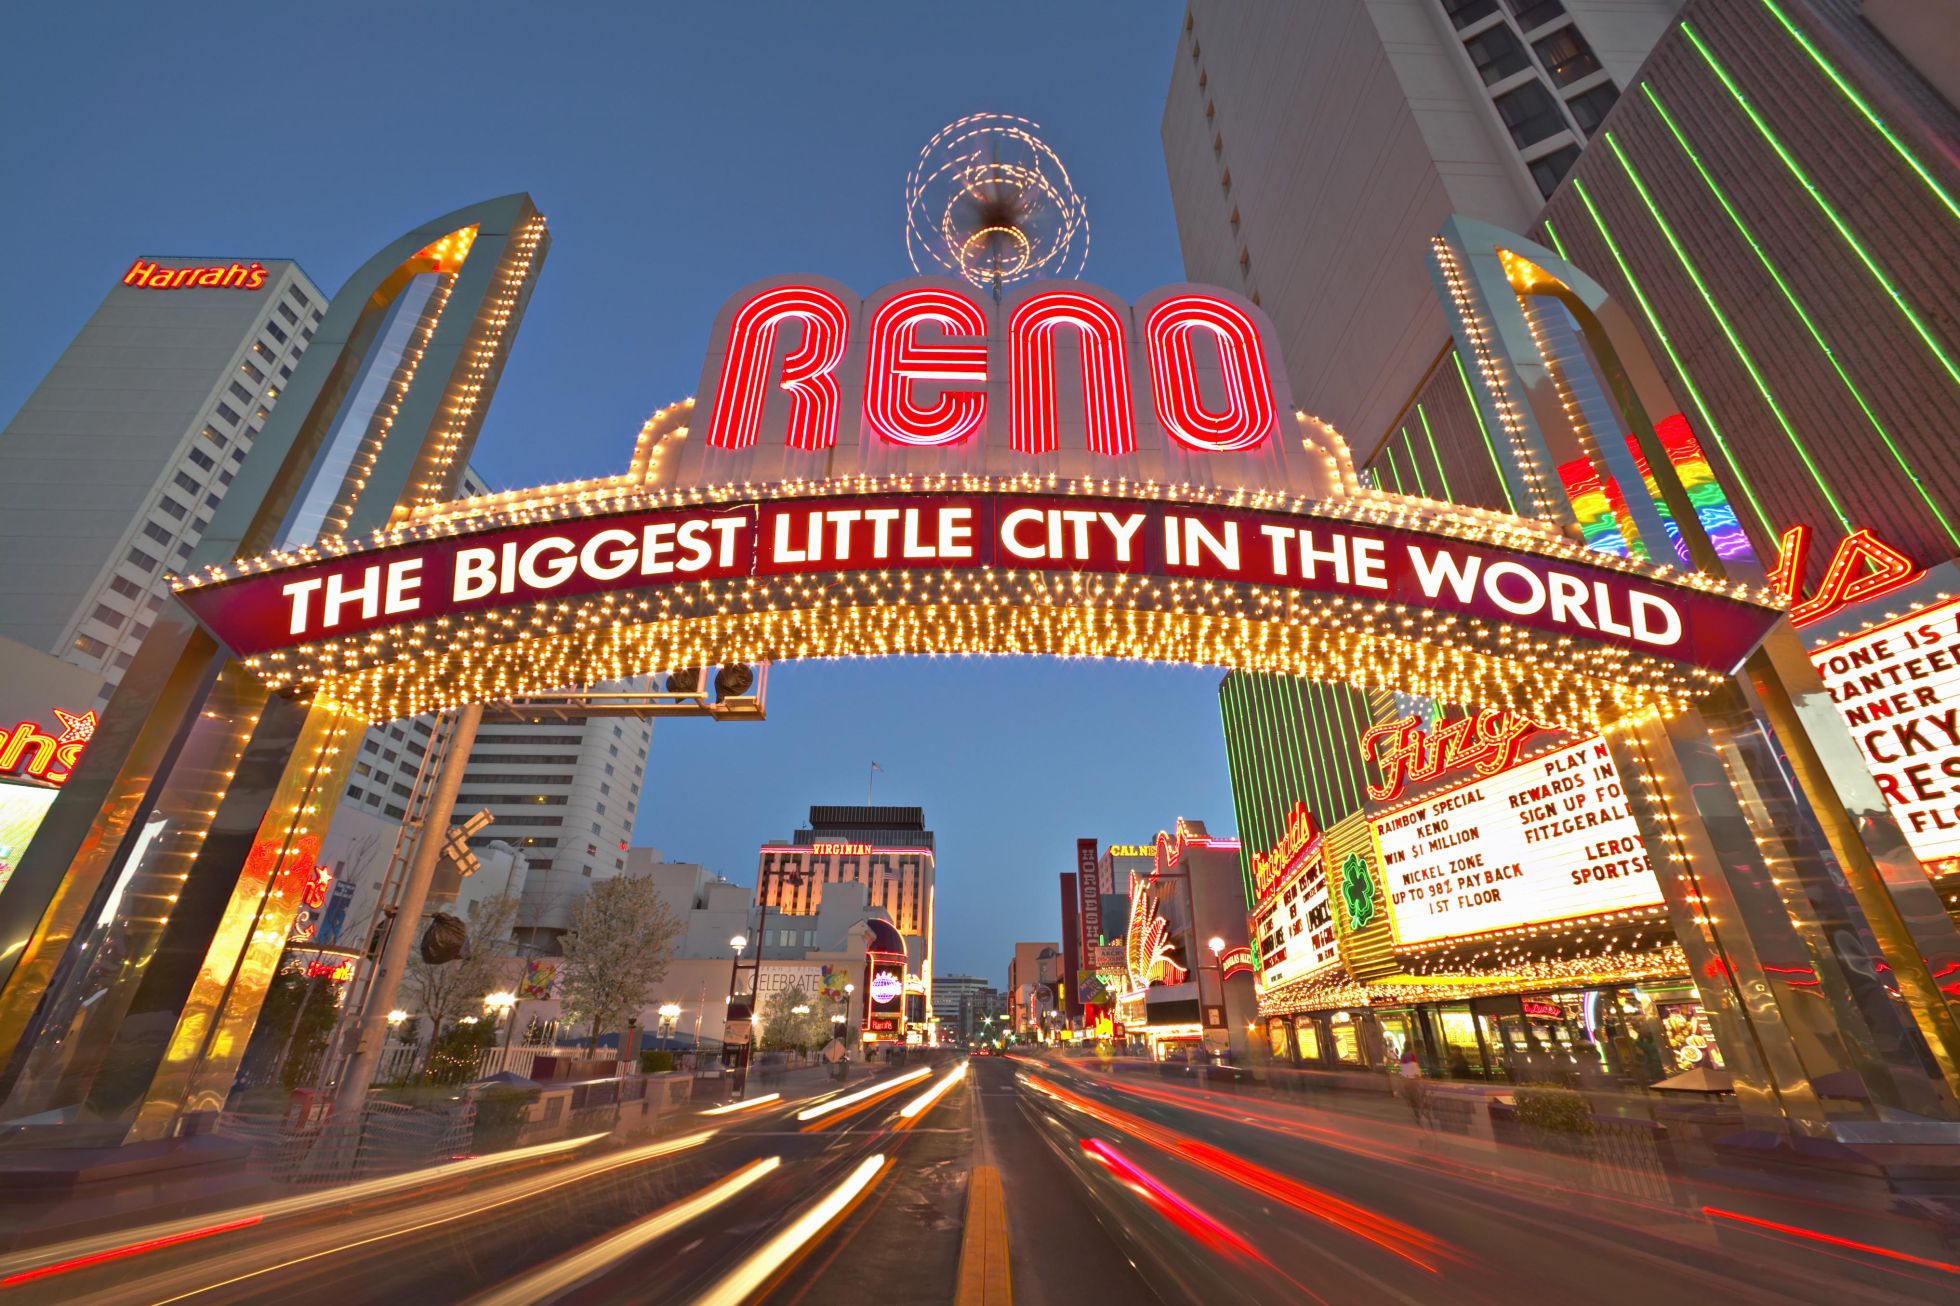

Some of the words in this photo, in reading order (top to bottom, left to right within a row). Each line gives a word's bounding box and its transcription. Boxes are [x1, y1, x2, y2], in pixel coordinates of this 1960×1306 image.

[123, 260, 268, 290] Harrah's
[282, 558, 422, 635] THE
[453, 516, 747, 602] BIGGEST
[772, 507, 973, 563] LITTLE
[1000, 508, 1146, 563] CITY
[1164, 516, 1240, 571] IN
[1261, 525, 1388, 590] THE
[1406, 545, 1683, 647] WORLD
[1904, 624, 1942, 649] IS
[1544, 750, 1587, 777] PLAY
[1509, 773, 1585, 809] REWARDS
[1377, 808, 1427, 837] RAINBOW
[1433, 788, 1486, 817] SPECIAL
[1519, 803, 1557, 826] SIGN
[1564, 794, 1586, 812] UP
[1416, 819, 1449, 839] KENO
[813, 843, 872, 855] VIRGINIAN
[1110, 845, 1138, 857] CAL
[1384, 850, 1406, 866] WIN
[1429, 827, 1480, 853] MILLION
[1402, 865, 1445, 886] NICKEL
[1449, 853, 1484, 875] ZONE
[1428, 879, 1452, 897] 98%
[1457, 888, 1502, 909] FLOOR
[748, 974, 820, 992] CELEBRATE
